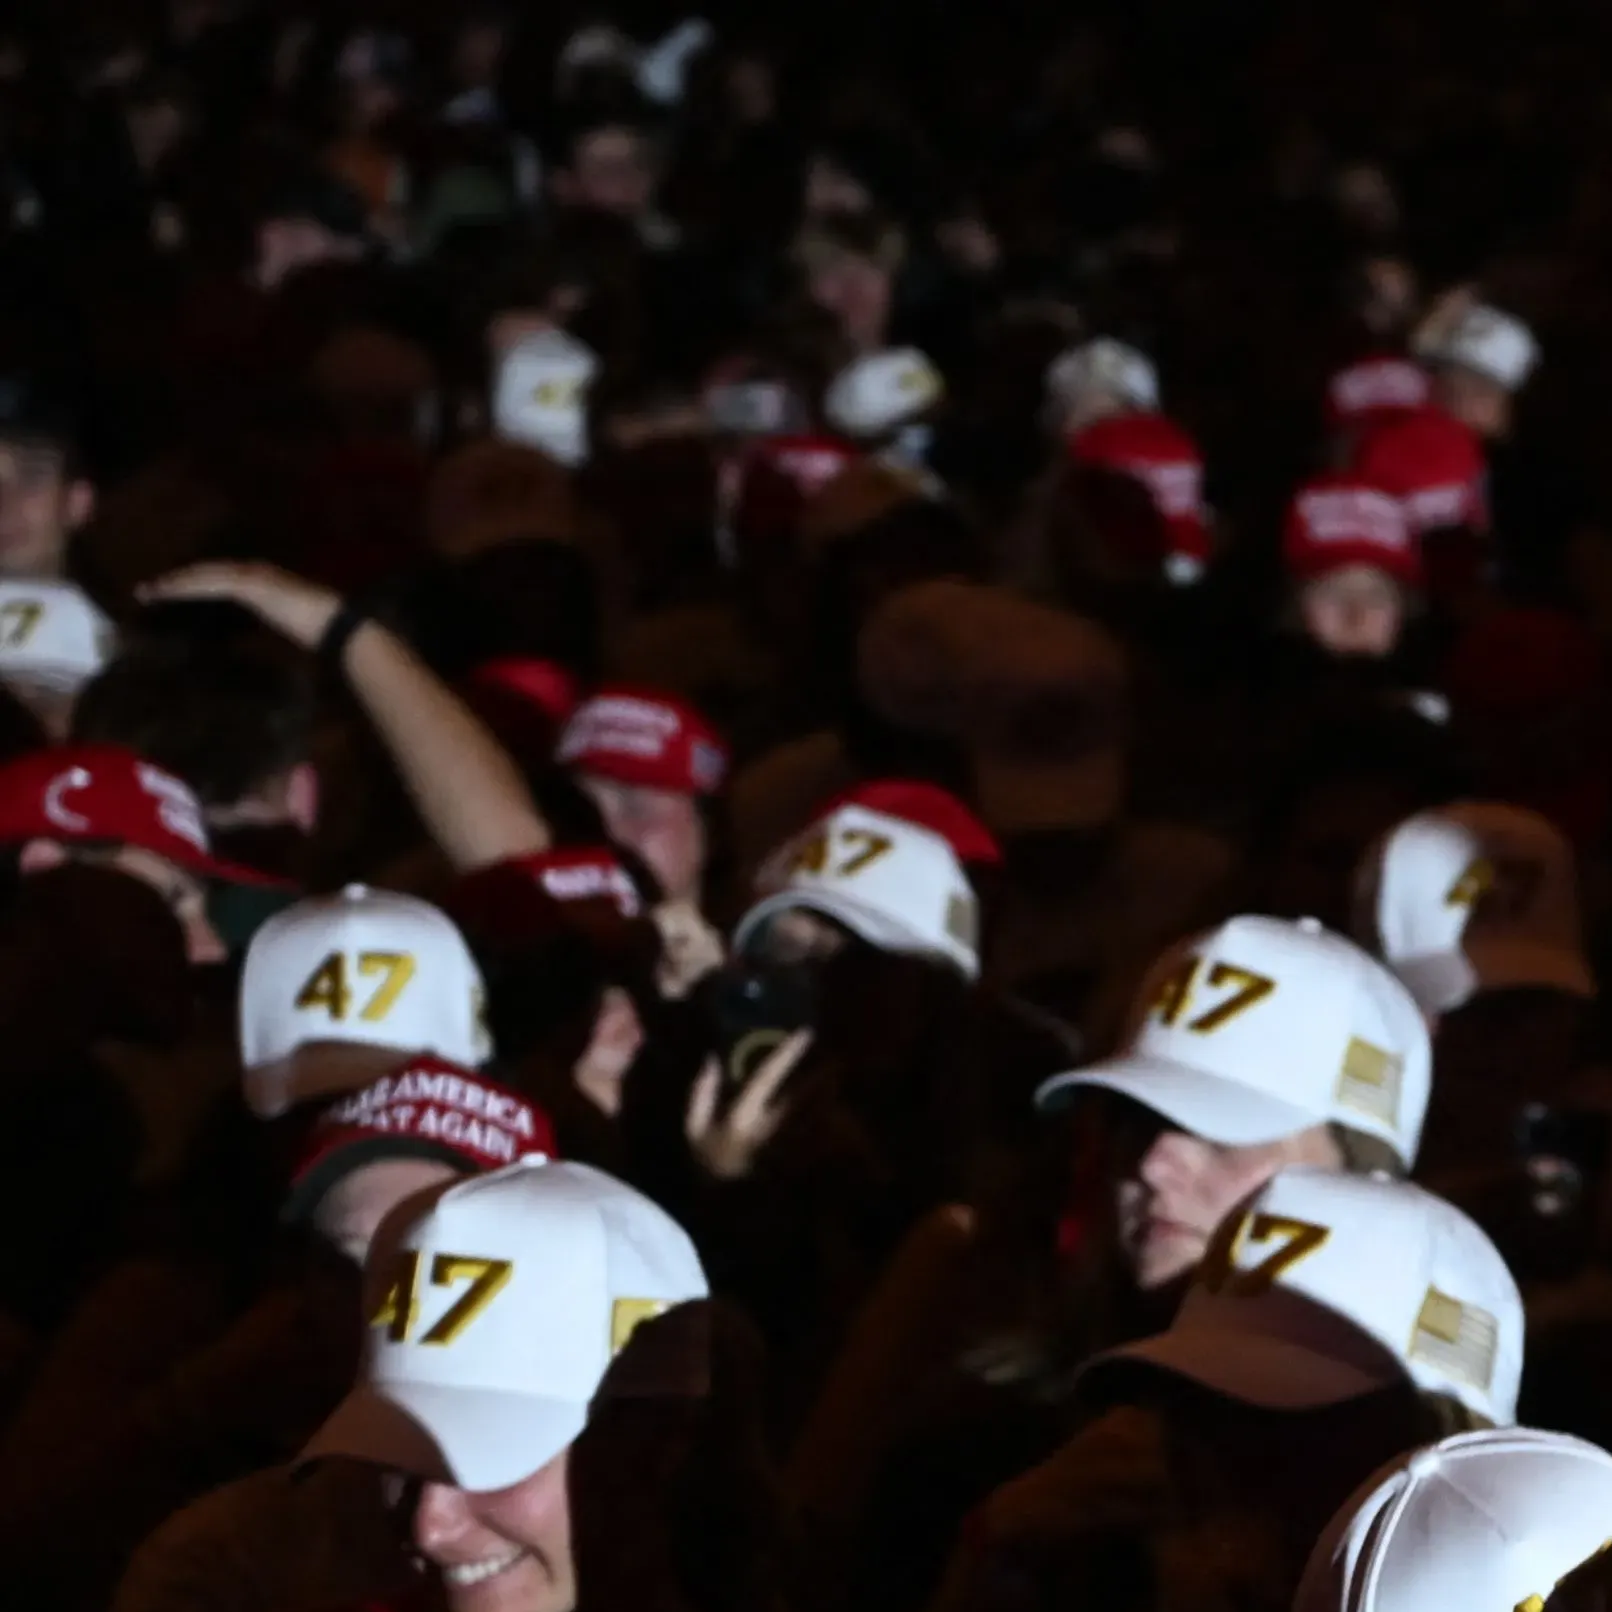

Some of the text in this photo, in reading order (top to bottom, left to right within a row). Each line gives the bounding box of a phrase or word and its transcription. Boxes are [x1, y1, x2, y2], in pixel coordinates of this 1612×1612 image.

[293, 949, 417, 1022] 47
[1150, 957, 1276, 1032] 47
[393, 1069, 536, 1140] AMERICA
[417, 1105, 515, 1163] AGAIN
[371, 1250, 516, 1346] 47
